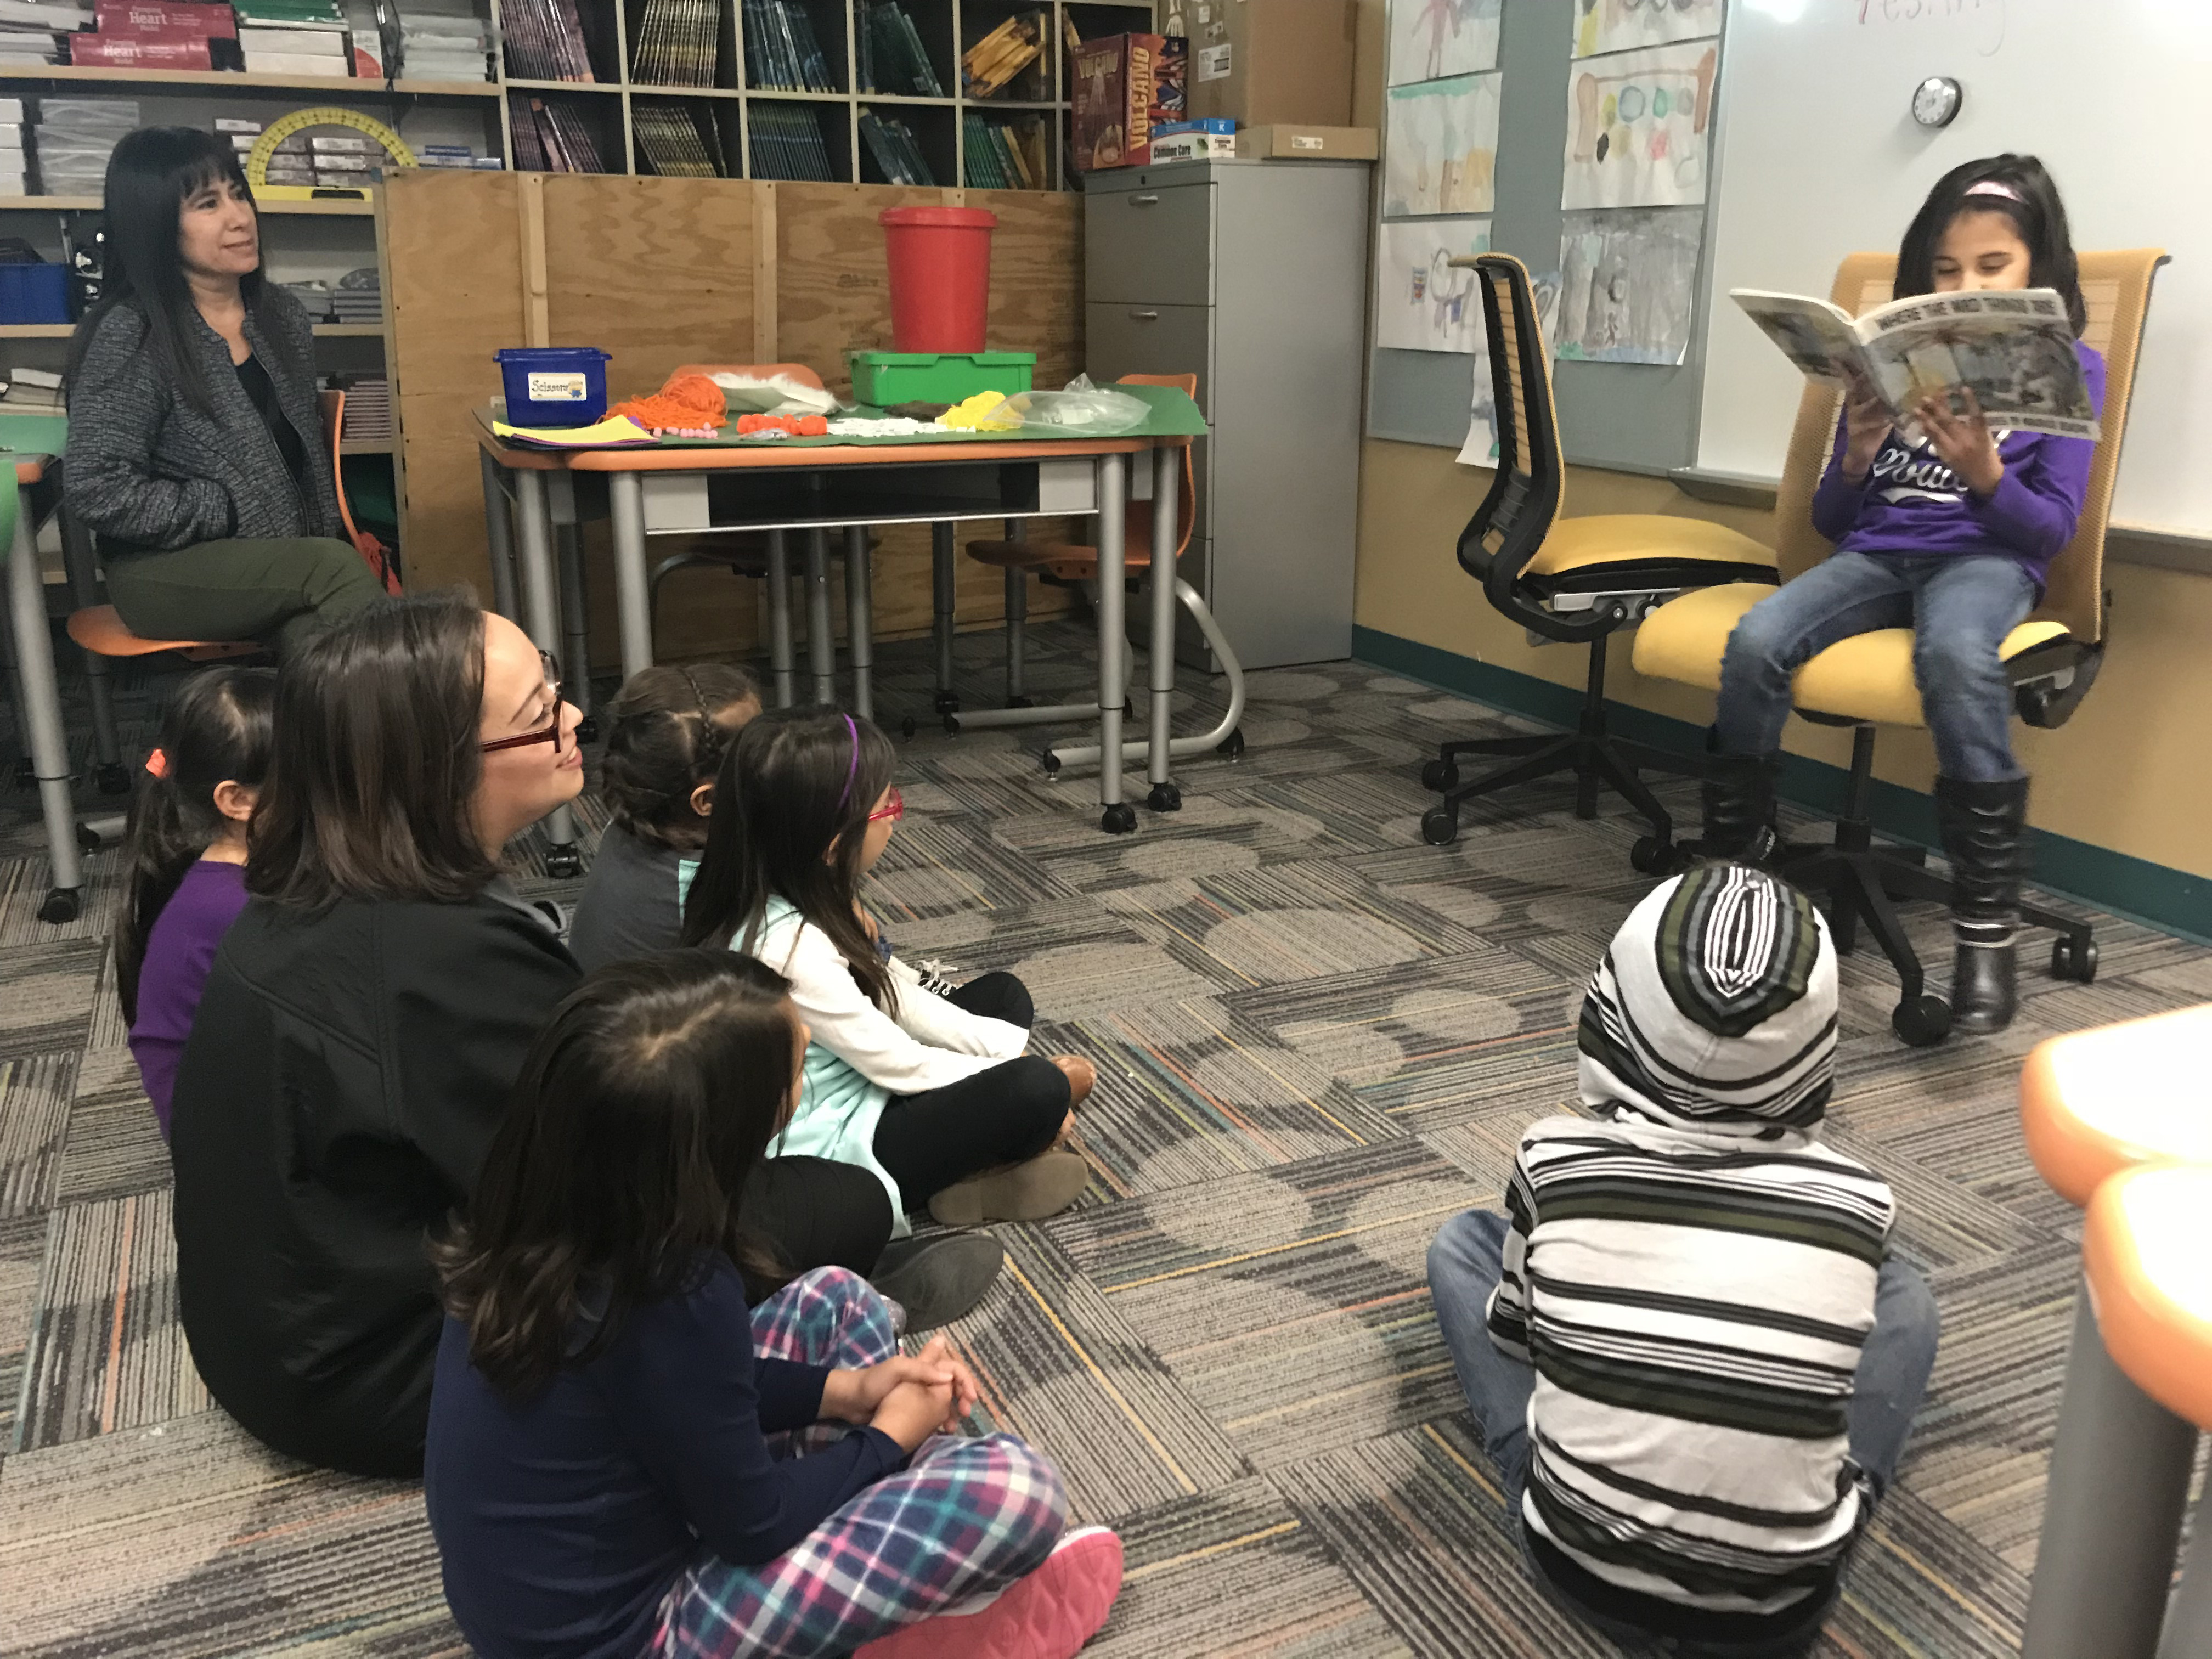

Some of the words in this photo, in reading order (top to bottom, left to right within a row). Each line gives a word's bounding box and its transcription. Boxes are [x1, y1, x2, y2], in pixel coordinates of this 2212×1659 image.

[129, 12, 168, 25] Heart
[103, 44, 142, 58] Heart
[1077, 52, 1119, 79] VOLCANO
[1130, 47, 1150, 151] VOLCANO
[1178, 144, 1191, 156] Core
[1875, 307, 1921, 331] WHERE
[1922, 302, 1948, 315] THE
[532, 380, 568, 392] Scissors
